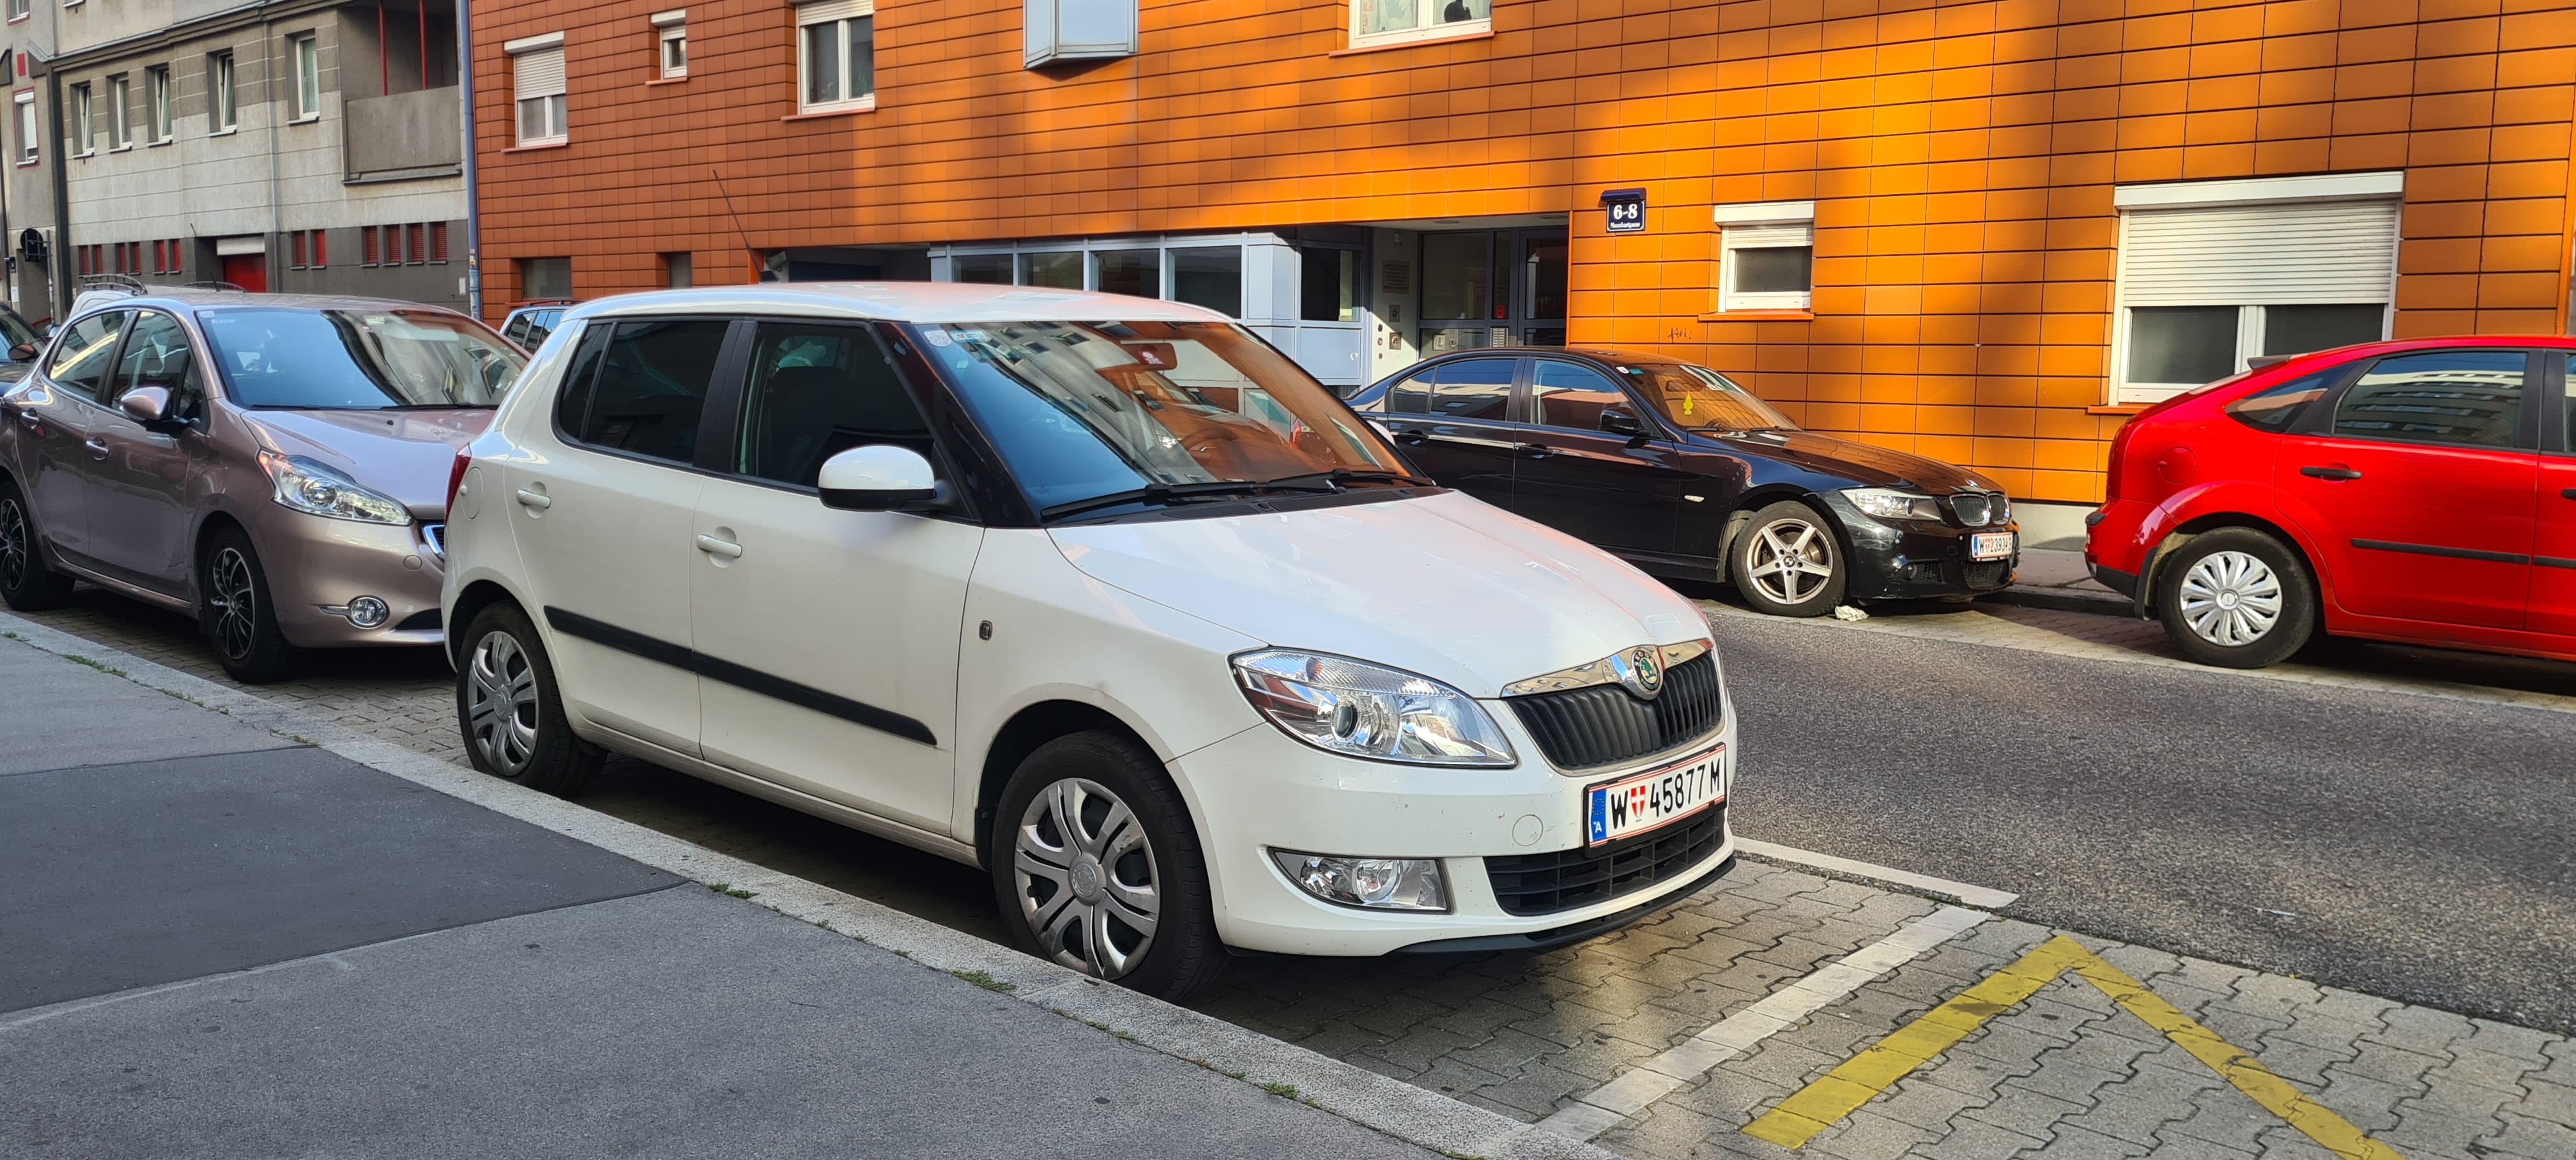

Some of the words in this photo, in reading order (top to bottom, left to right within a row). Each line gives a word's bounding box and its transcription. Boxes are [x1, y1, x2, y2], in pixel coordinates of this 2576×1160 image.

[1613, 204, 1637, 220] 6-8
[1611, 790, 1629, 829] W
[1594, 821, 1602, 833] A
